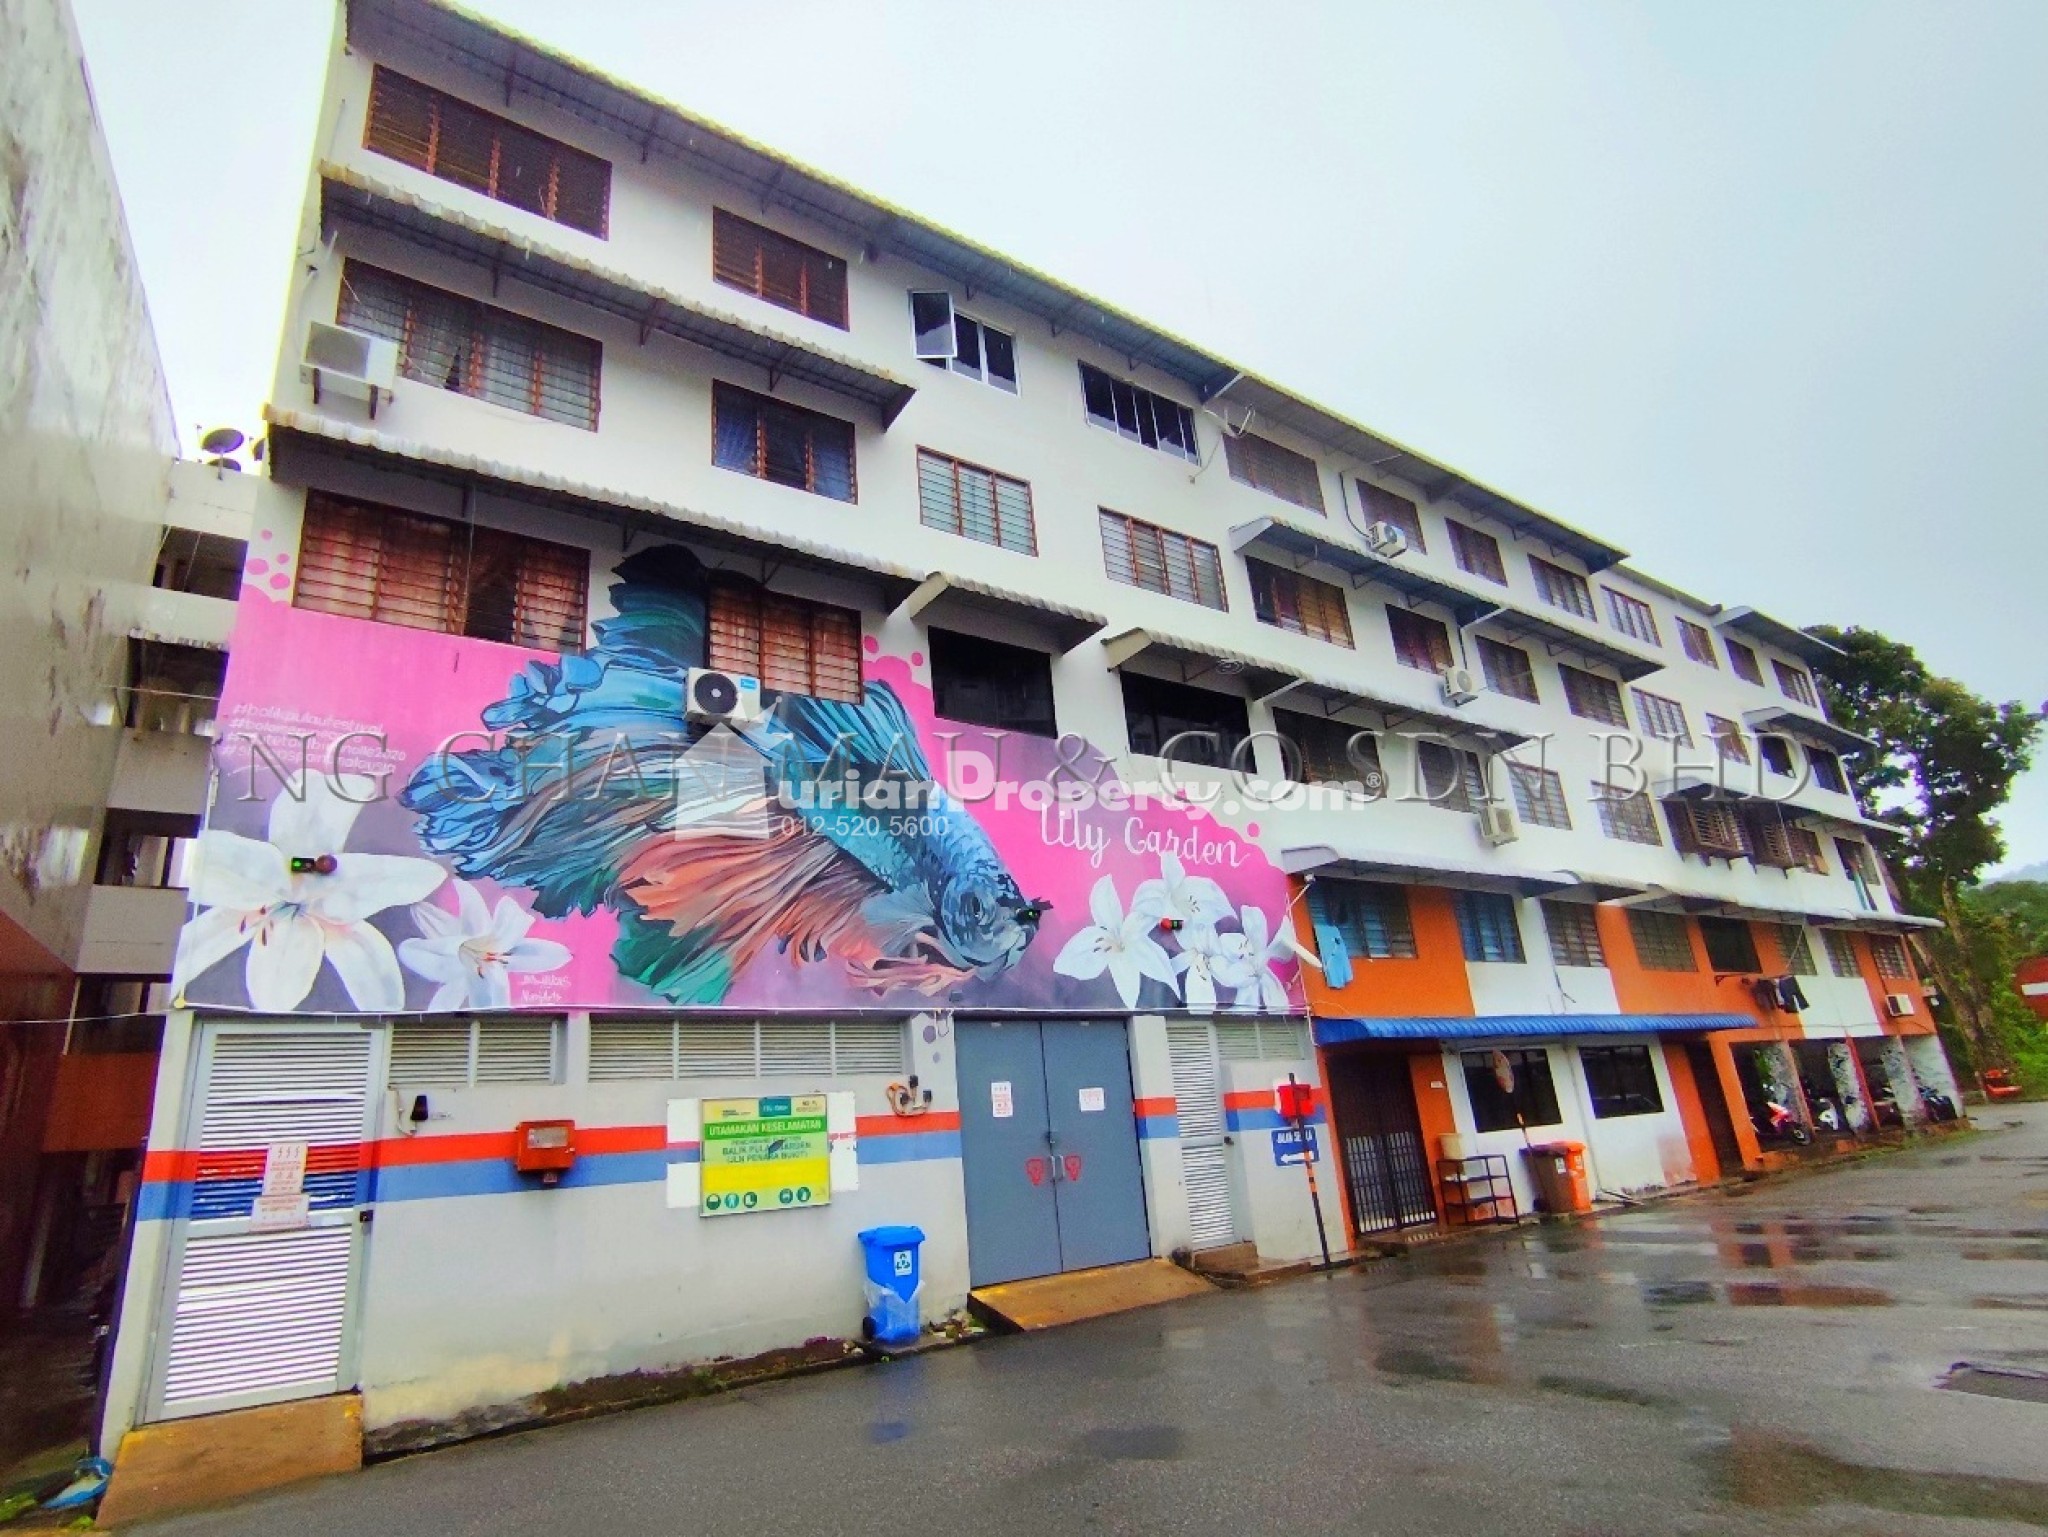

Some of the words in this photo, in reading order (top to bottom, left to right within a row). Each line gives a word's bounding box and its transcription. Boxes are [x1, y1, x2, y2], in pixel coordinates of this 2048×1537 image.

[1124, 815, 1251, 868] Garden
[709, 1123, 759, 1136] UTAMAKAN
[761, 1119, 821, 1133] KESELAMATAN
[1294, 1130, 1313, 1142] SELA
